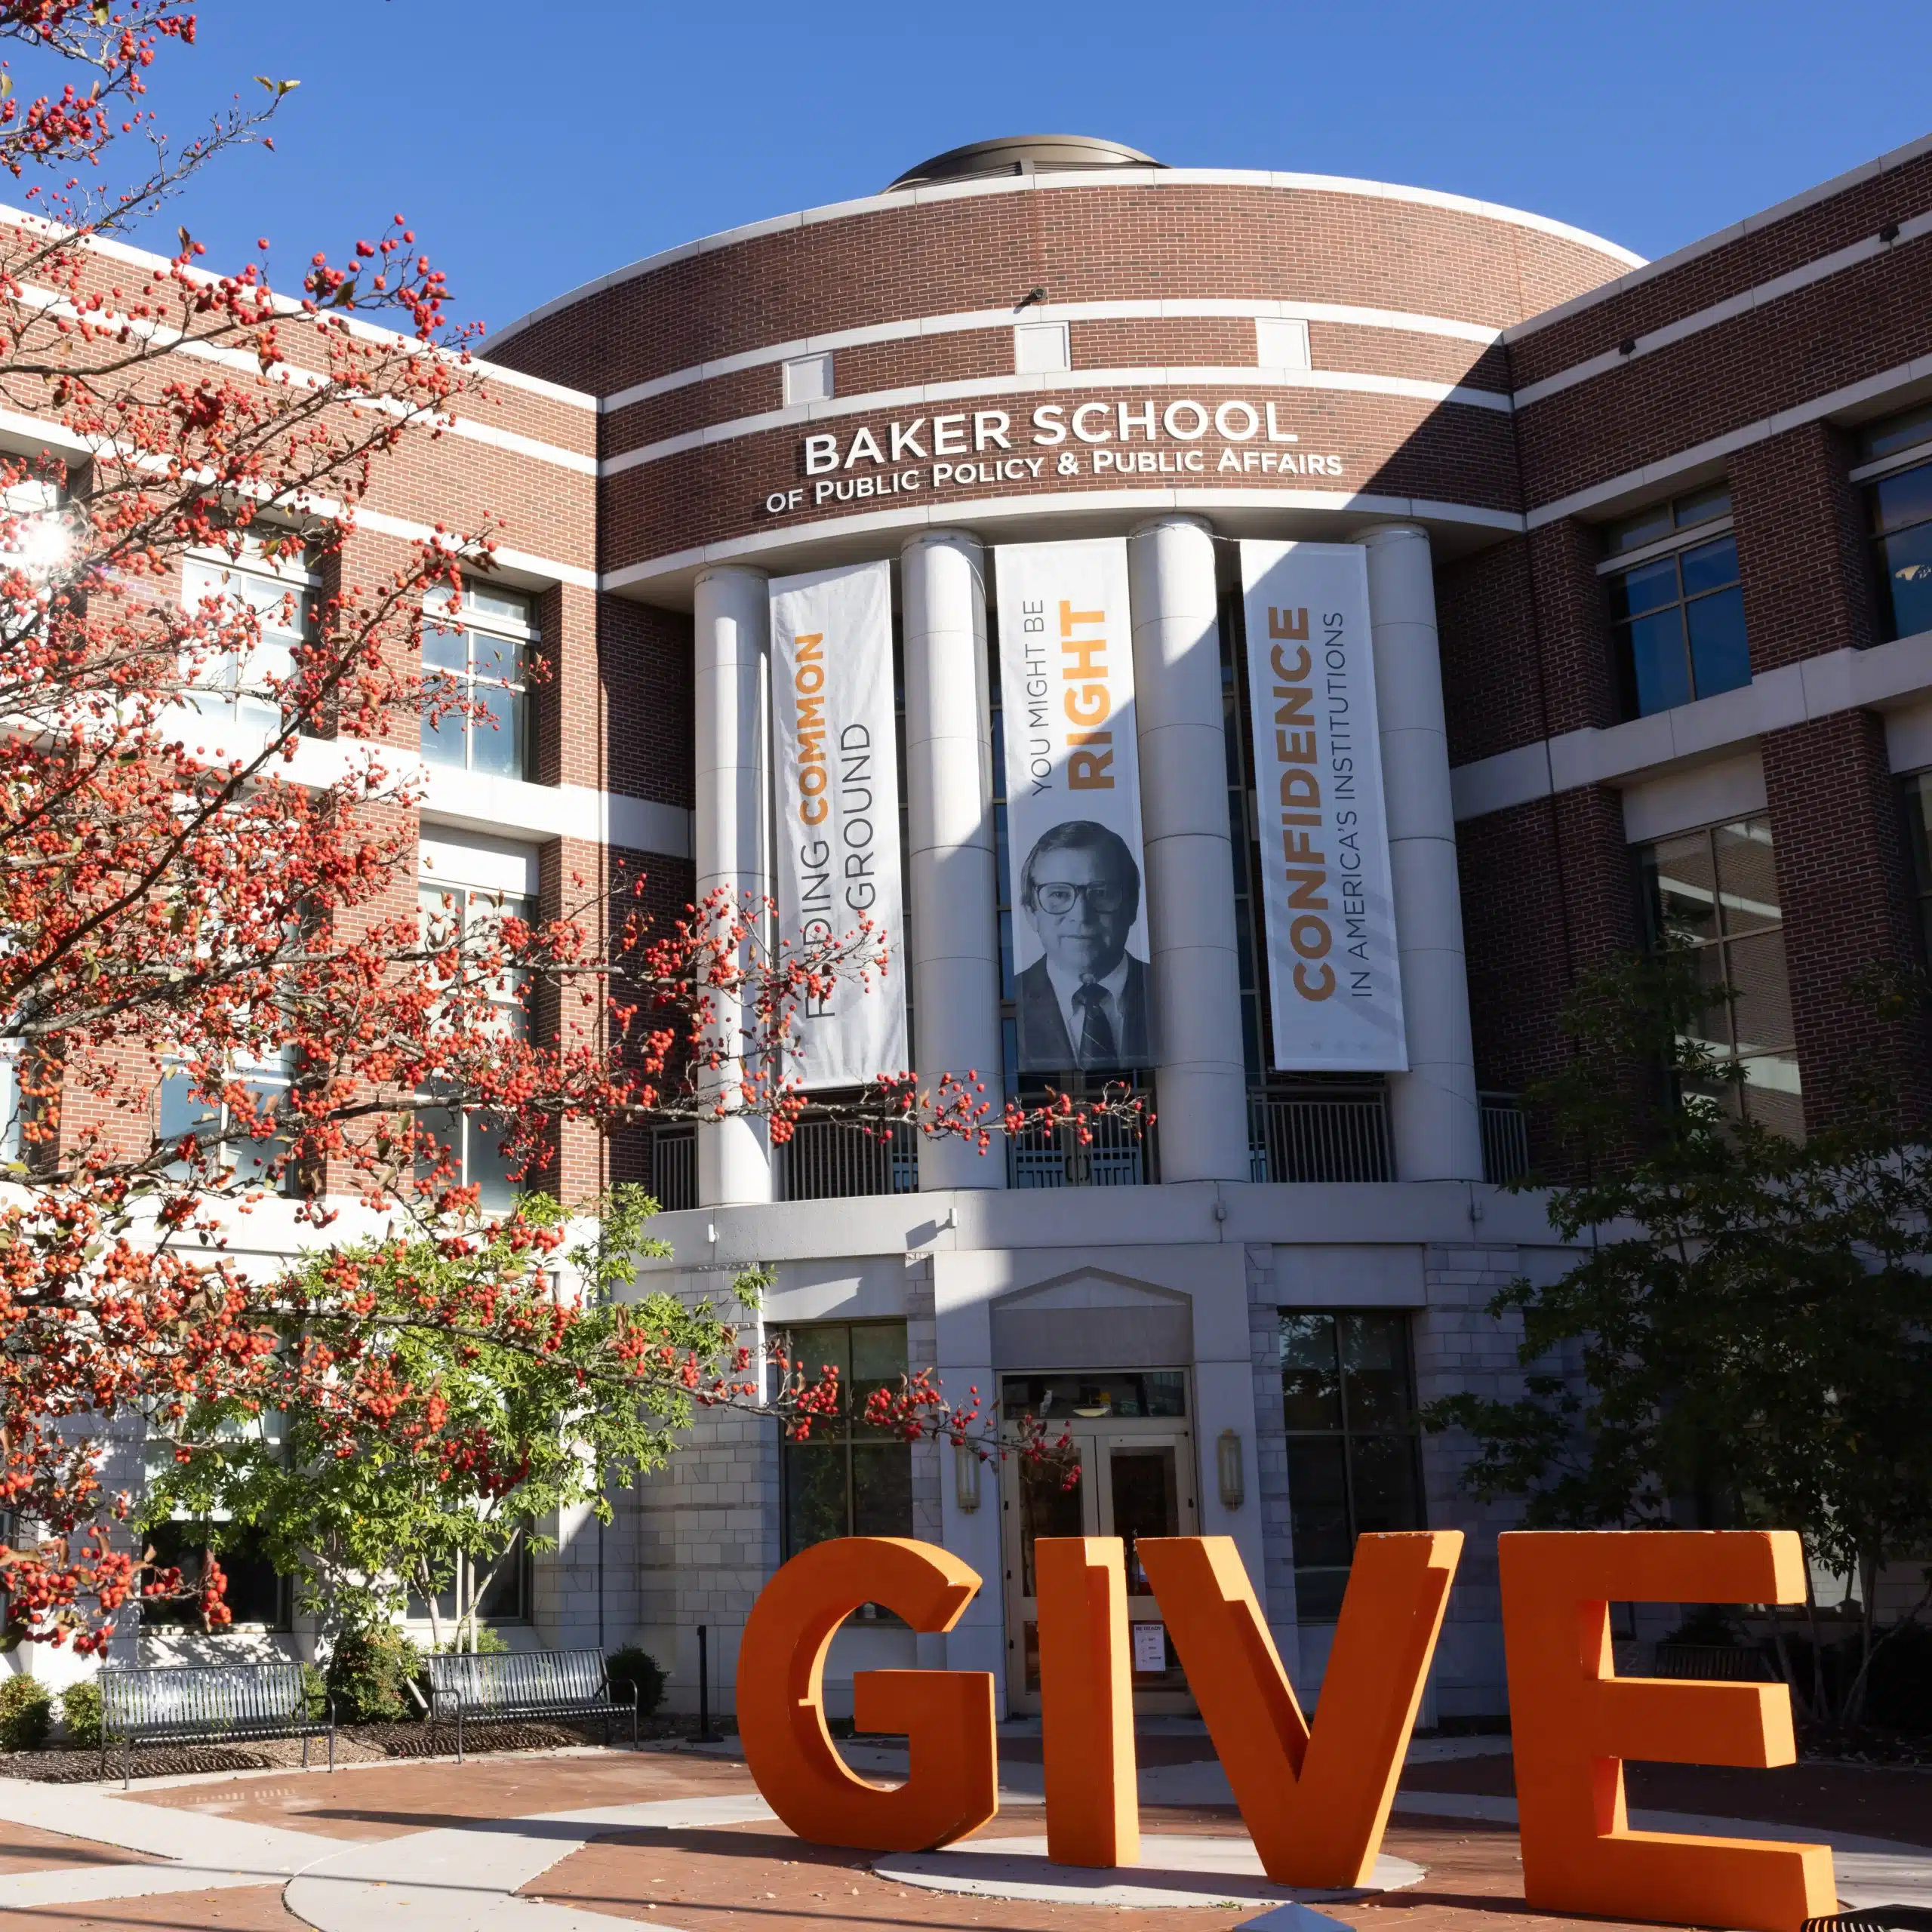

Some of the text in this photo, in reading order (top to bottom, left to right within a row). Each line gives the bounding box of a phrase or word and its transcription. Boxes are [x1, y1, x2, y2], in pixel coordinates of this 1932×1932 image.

[766, 448, 1343, 513] OF PUBLIC POLICY & PUBLIC AFFAIRS
[805, 399, 1299, 475] BAKER SCHOOL
[795, 632, 829, 826] COMMON
[1023, 599, 1052, 797] YOU MIGHT BE
[1059, 600, 1115, 791] RIGHT
[840, 723, 876, 910] GROUND
[1268, 606, 1337, 1001] CONFIDENCE
[1322, 611, 1373, 998] IN AMERICA'S INSTITUTIONS
[738, 1530, 1838, 1932] GIVE
